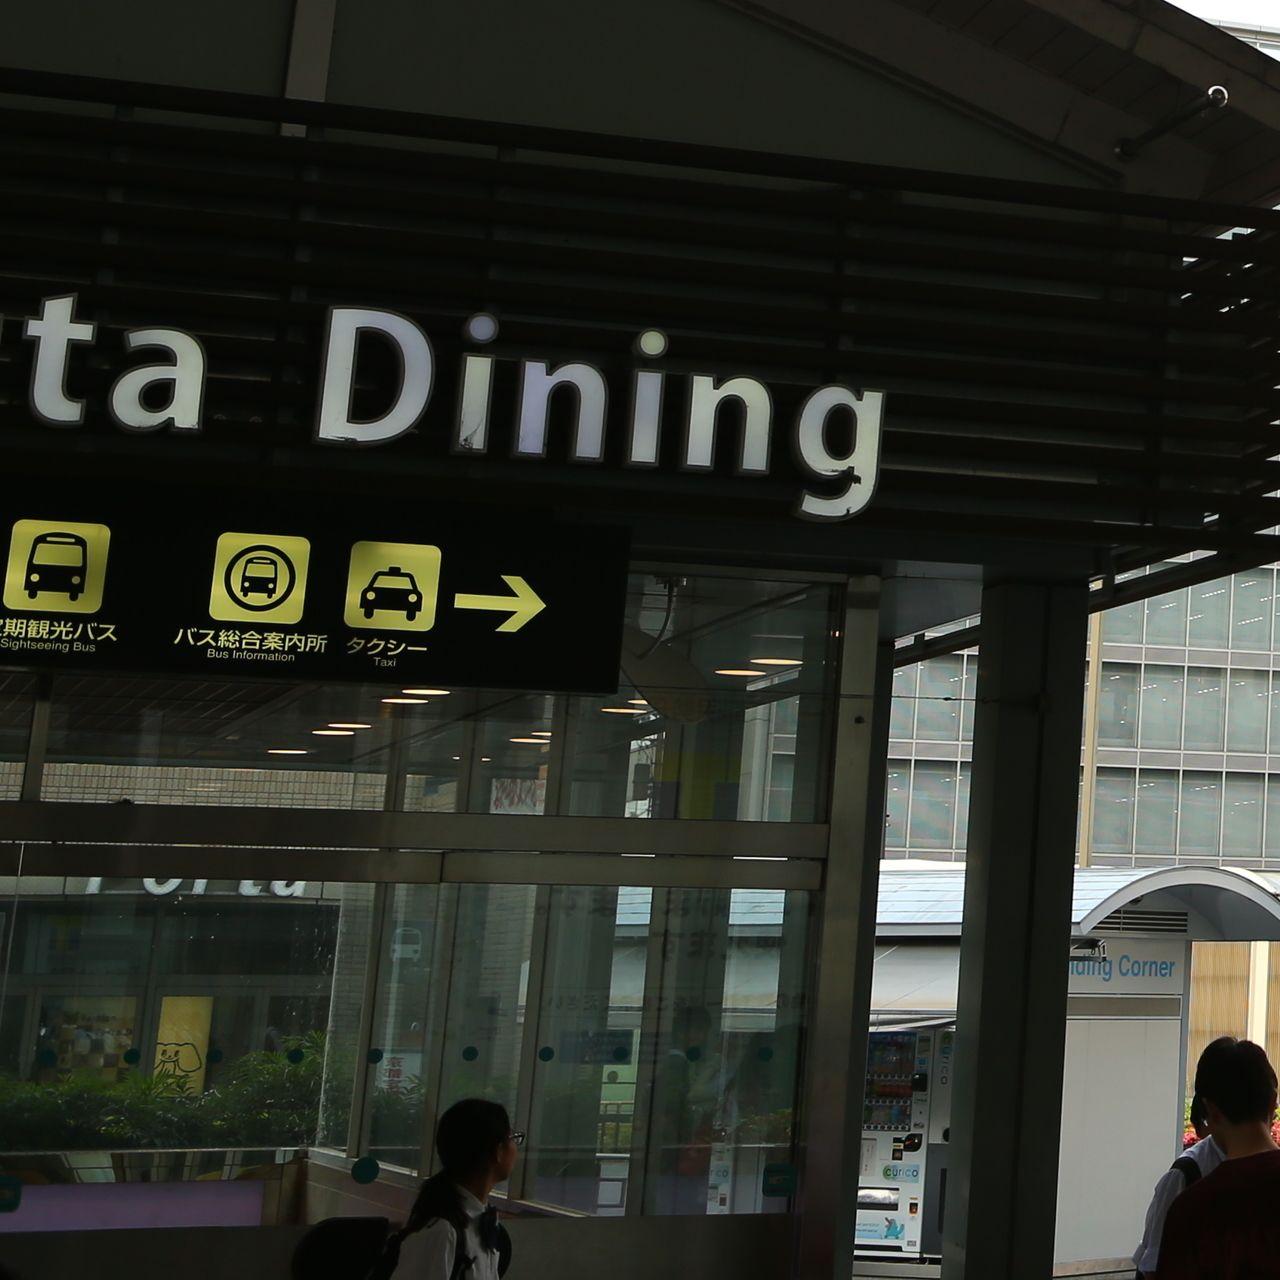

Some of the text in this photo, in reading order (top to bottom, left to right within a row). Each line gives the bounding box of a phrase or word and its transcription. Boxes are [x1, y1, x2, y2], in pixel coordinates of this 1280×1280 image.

[315, 305, 887, 519] Dining
[0, 638, 96, 652] Sightseeing Bus
[174, 627, 328, 653] バス総合案内所
[347, 637, 428, 656] タクシー
[207, 648, 295, 662] Bus Information
[373, 656, 397, 667] Taxi
[1118, 954, 1176, 977] Corner
